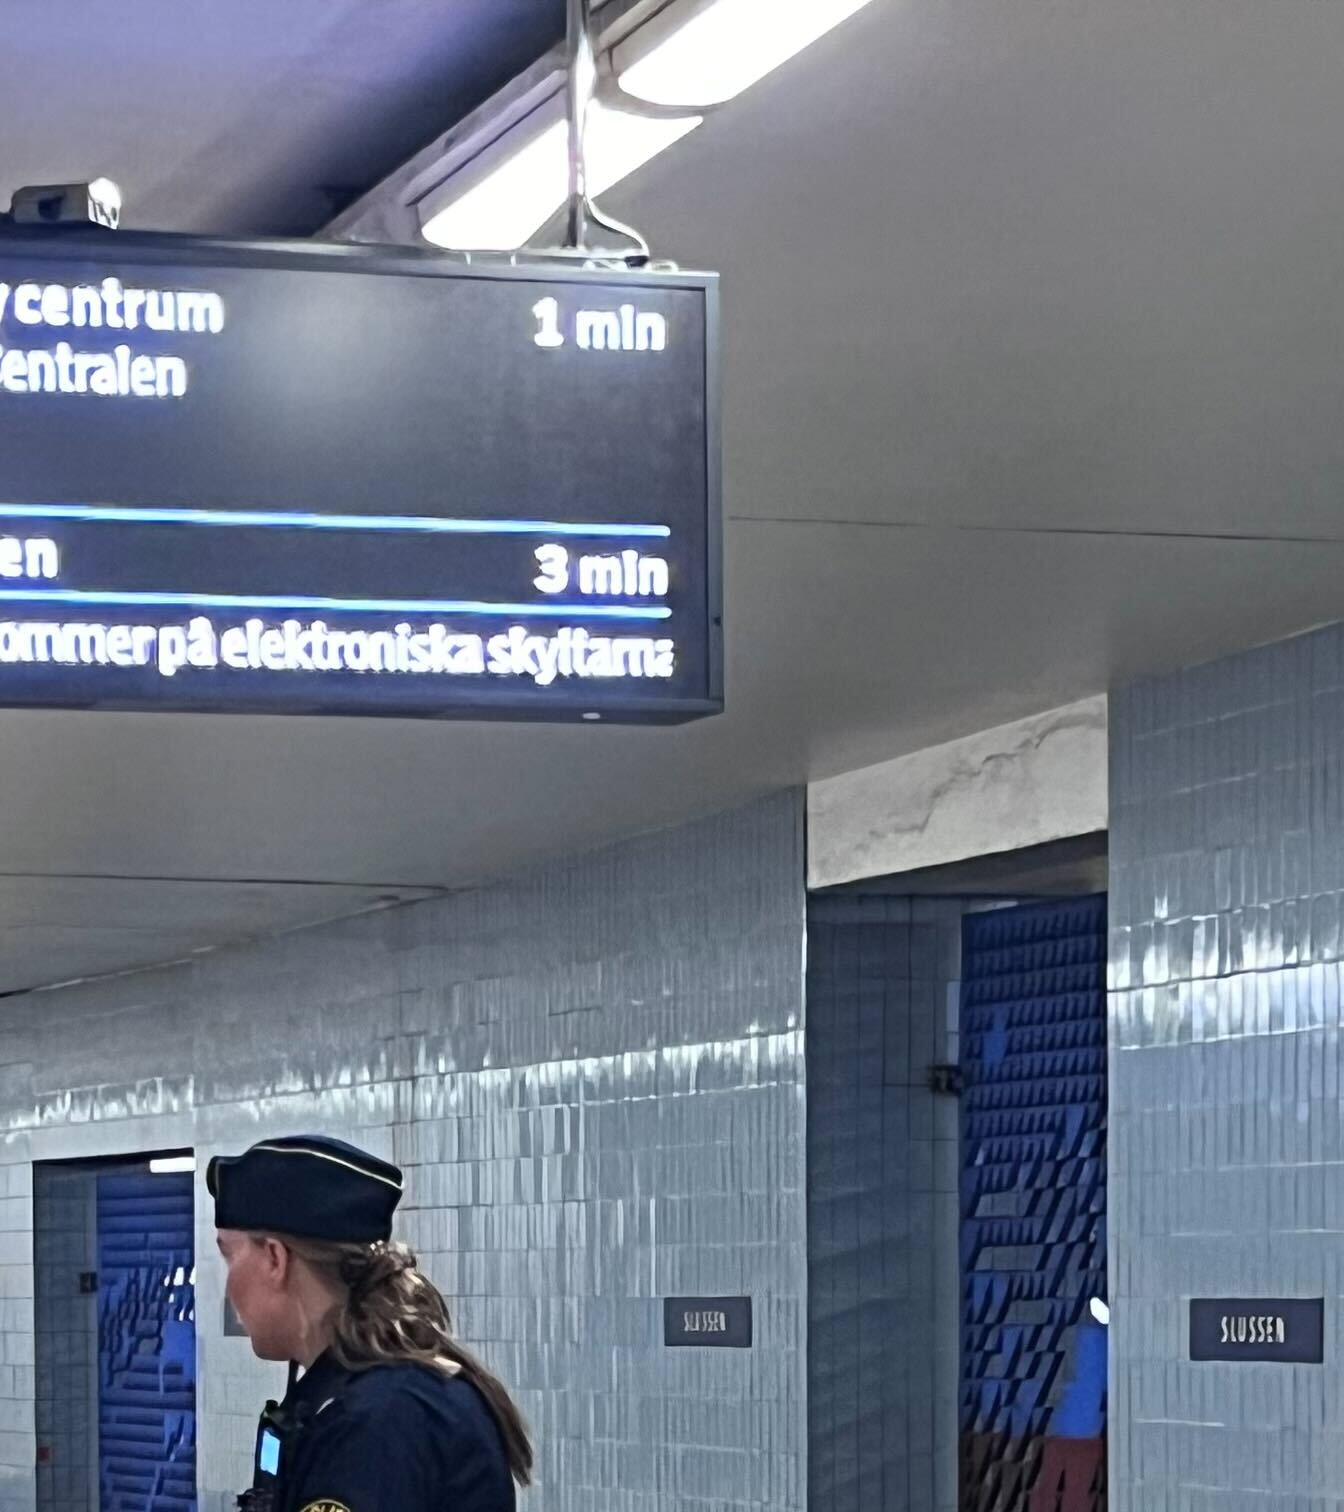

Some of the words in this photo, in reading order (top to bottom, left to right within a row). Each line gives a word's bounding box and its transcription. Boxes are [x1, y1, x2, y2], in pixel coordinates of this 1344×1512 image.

[14, 277, 225, 333] centrum
[532, 297, 564, 347] 1
[576, 303, 665, 351] min
[533, 543, 568, 593] 3
[578, 549, 669, 596] min
[158, 616, 217, 676] på
[221, 618, 485, 675] elektroniska
[1220, 1315, 1284, 1343] SLUSSEN
